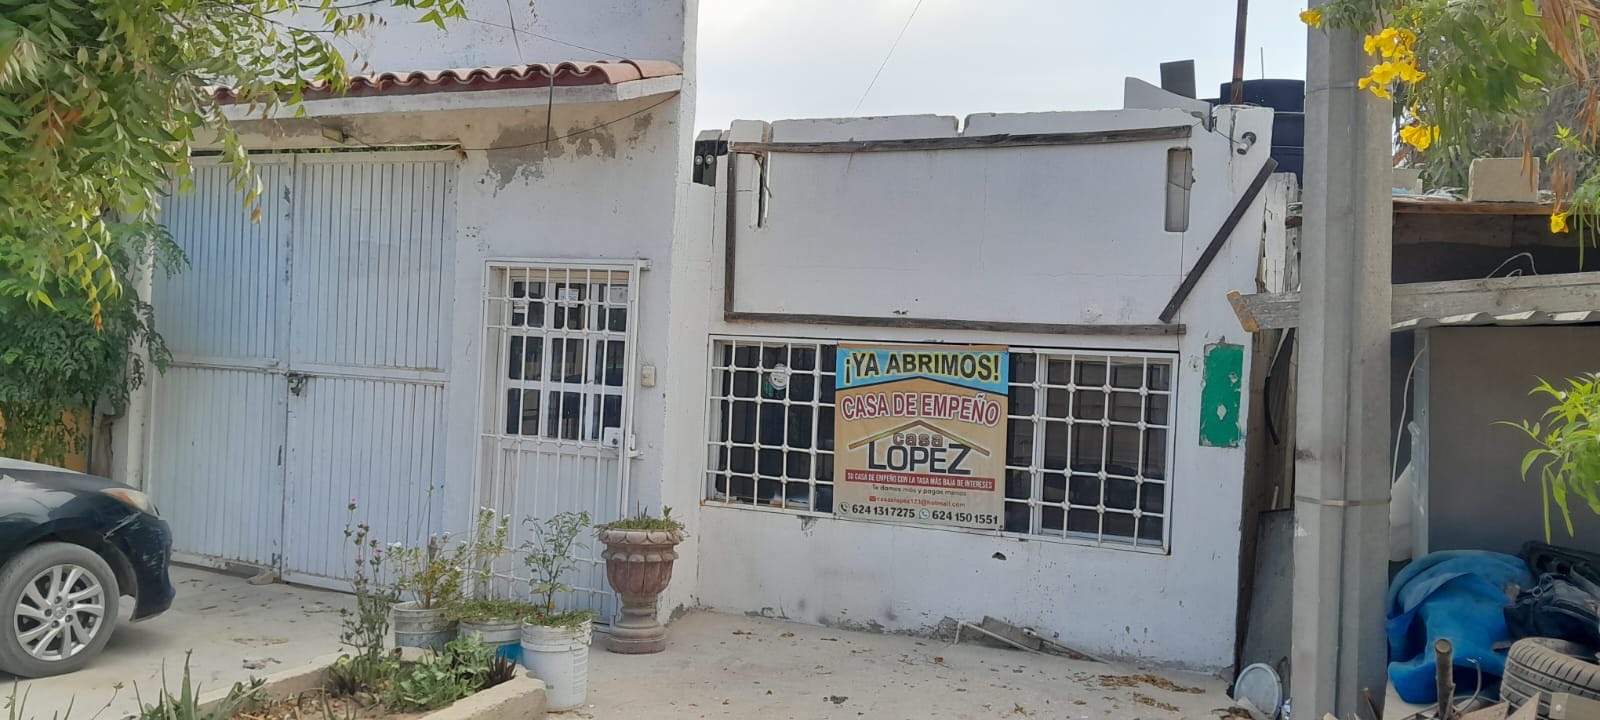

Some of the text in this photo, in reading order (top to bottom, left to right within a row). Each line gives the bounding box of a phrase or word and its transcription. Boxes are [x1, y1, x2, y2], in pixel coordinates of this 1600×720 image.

[845, 352, 1000, 384] ¡YA ABRIMOS!
[842, 392, 999, 426] CASA DE EMPEÑO
[893, 432, 943, 447] casa
[854, 473, 868, 481] CASA
[868, 473, 875, 481] DE
[875, 473, 897, 482] EMPEÑO
[897, 475, 908, 483] CON
[908, 475, 916, 484] LA
[942, 478, 956, 487] BAJA
[956, 479, 964, 487] DE
[852, 504, 871, 514] 624
[932, 510, 953, 521] 624
[955, 512, 972, 522] 150
[974, 514, 998, 525] 1551
